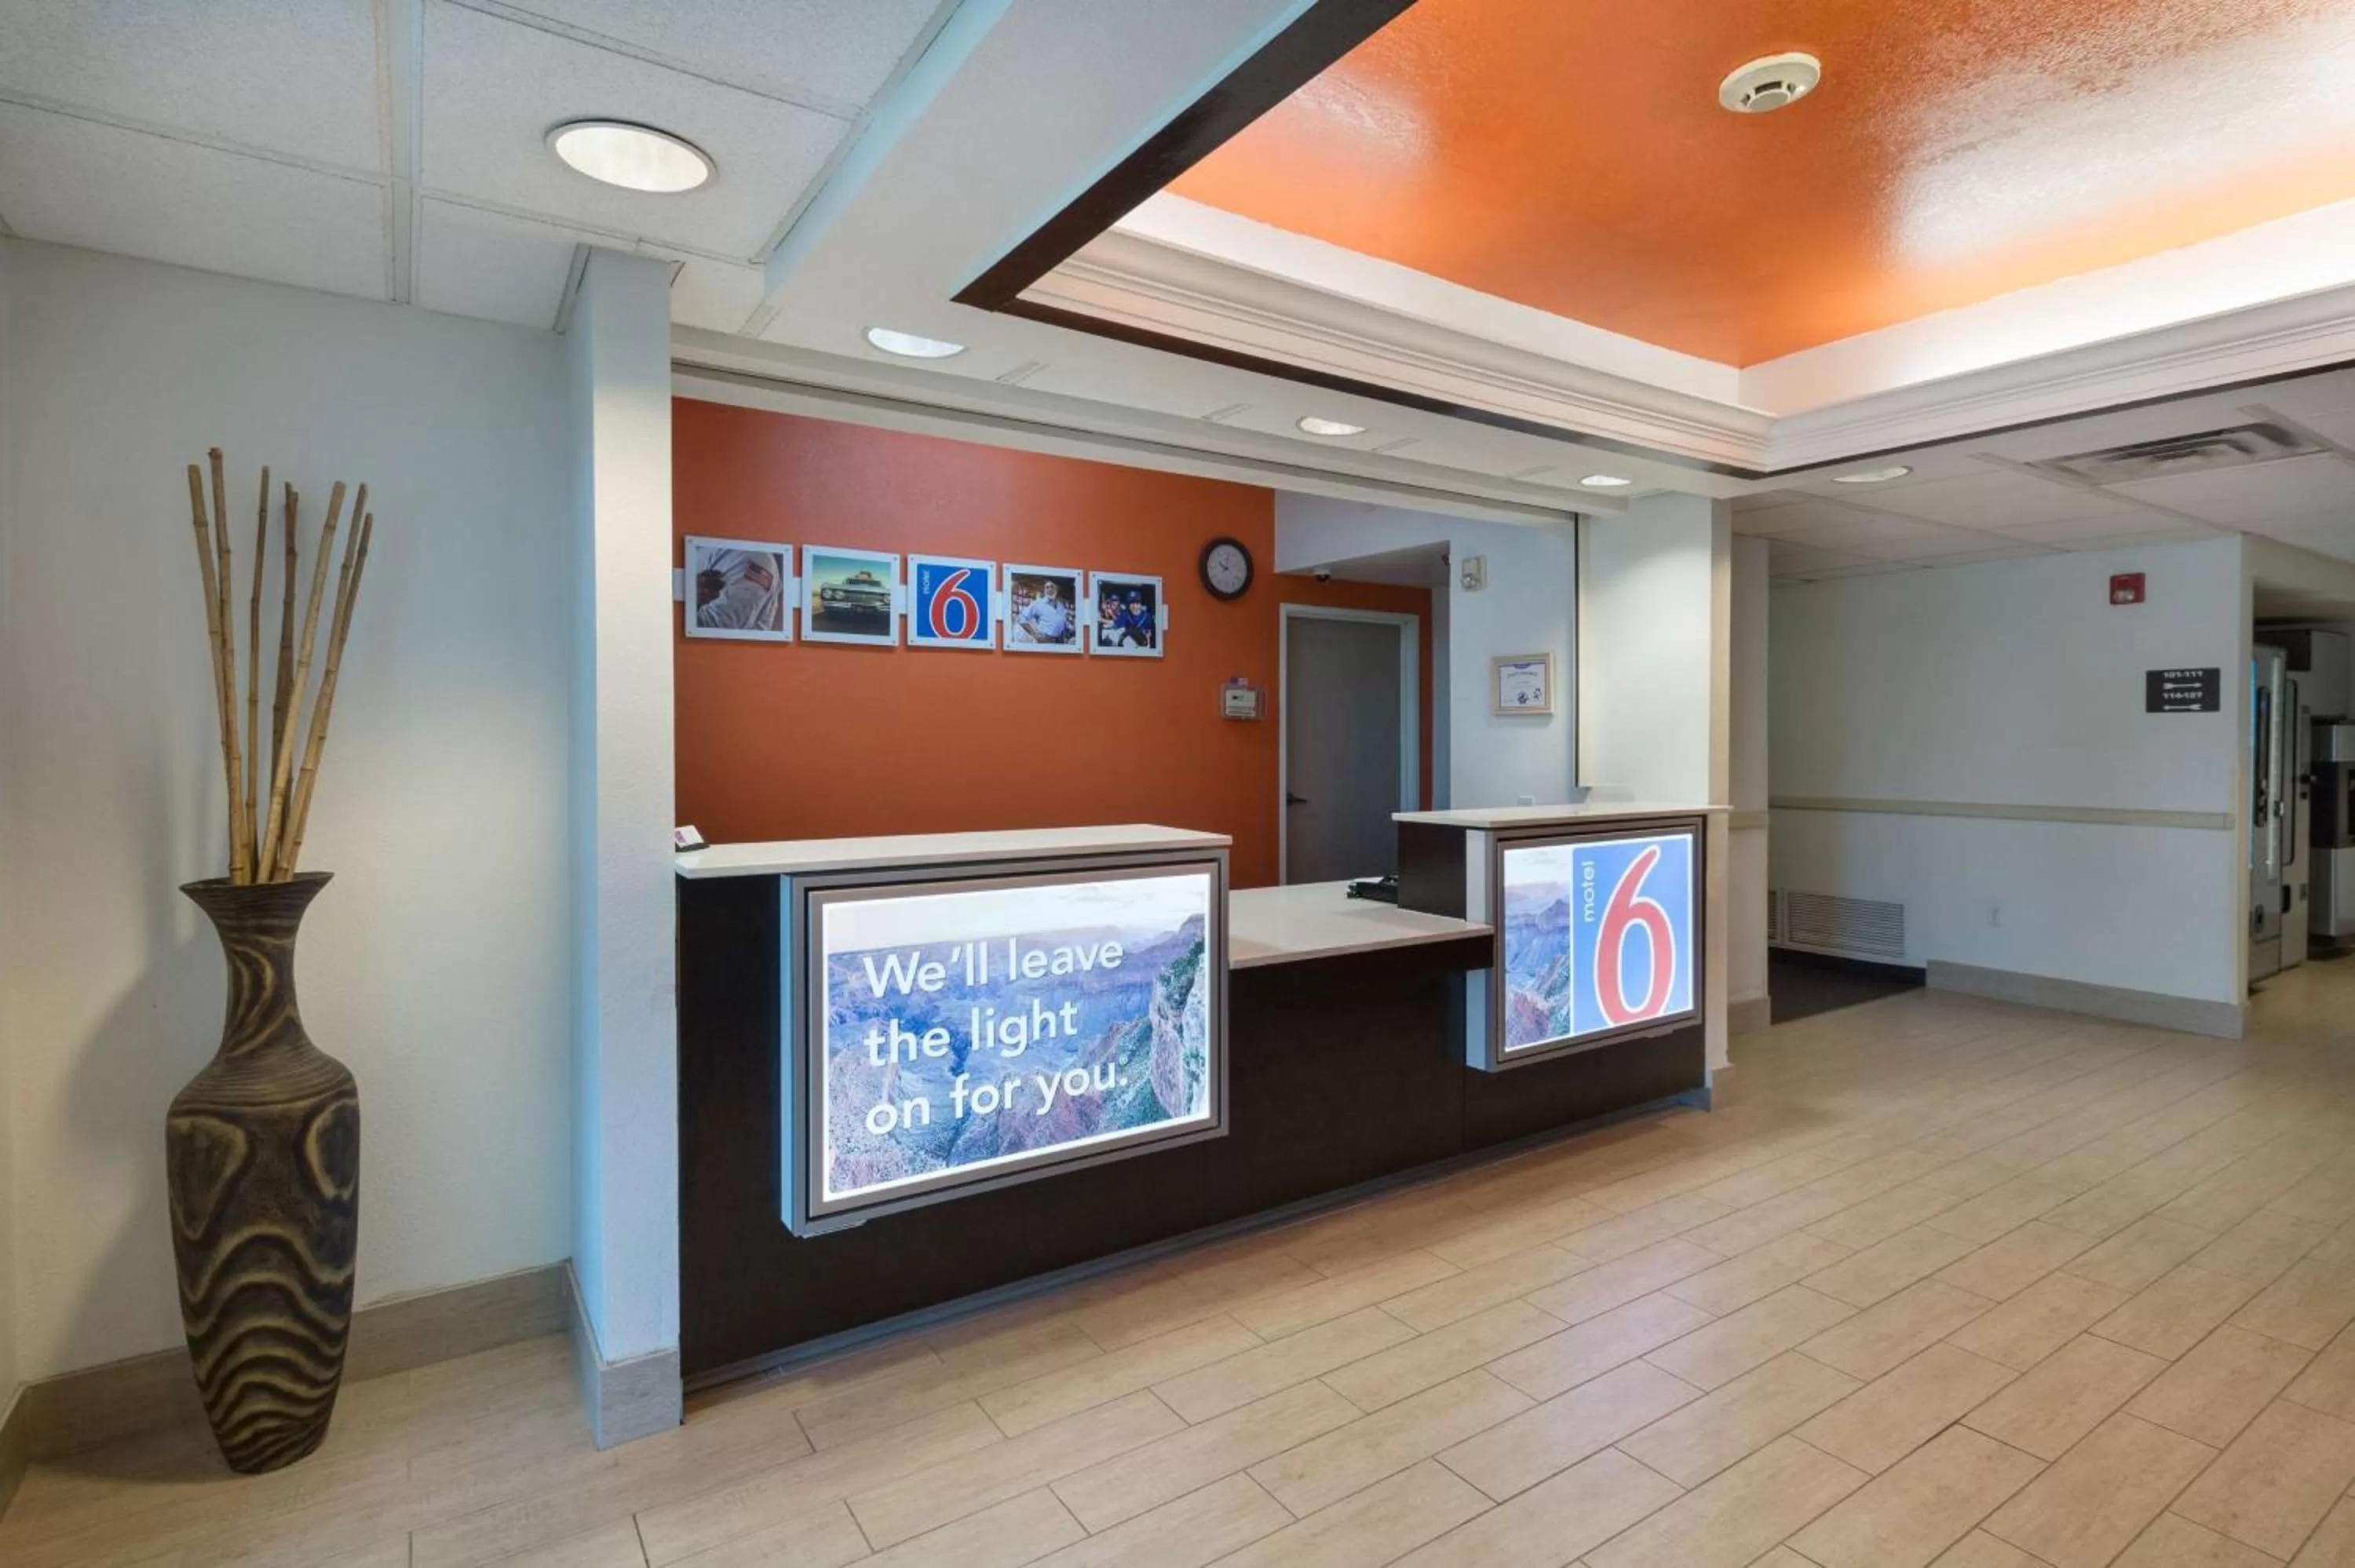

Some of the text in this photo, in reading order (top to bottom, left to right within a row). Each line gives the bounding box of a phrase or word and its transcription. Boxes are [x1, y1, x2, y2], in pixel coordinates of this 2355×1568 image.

[929, 569, 980, 640] 6
[863, 937, 1124, 998] We'll leave
[1582, 844, 1675, 1026] motel 6
[864, 998, 1079, 1067] the light
[865, 1096, 930, 1135] on
[950, 1074, 1020, 1118] for
